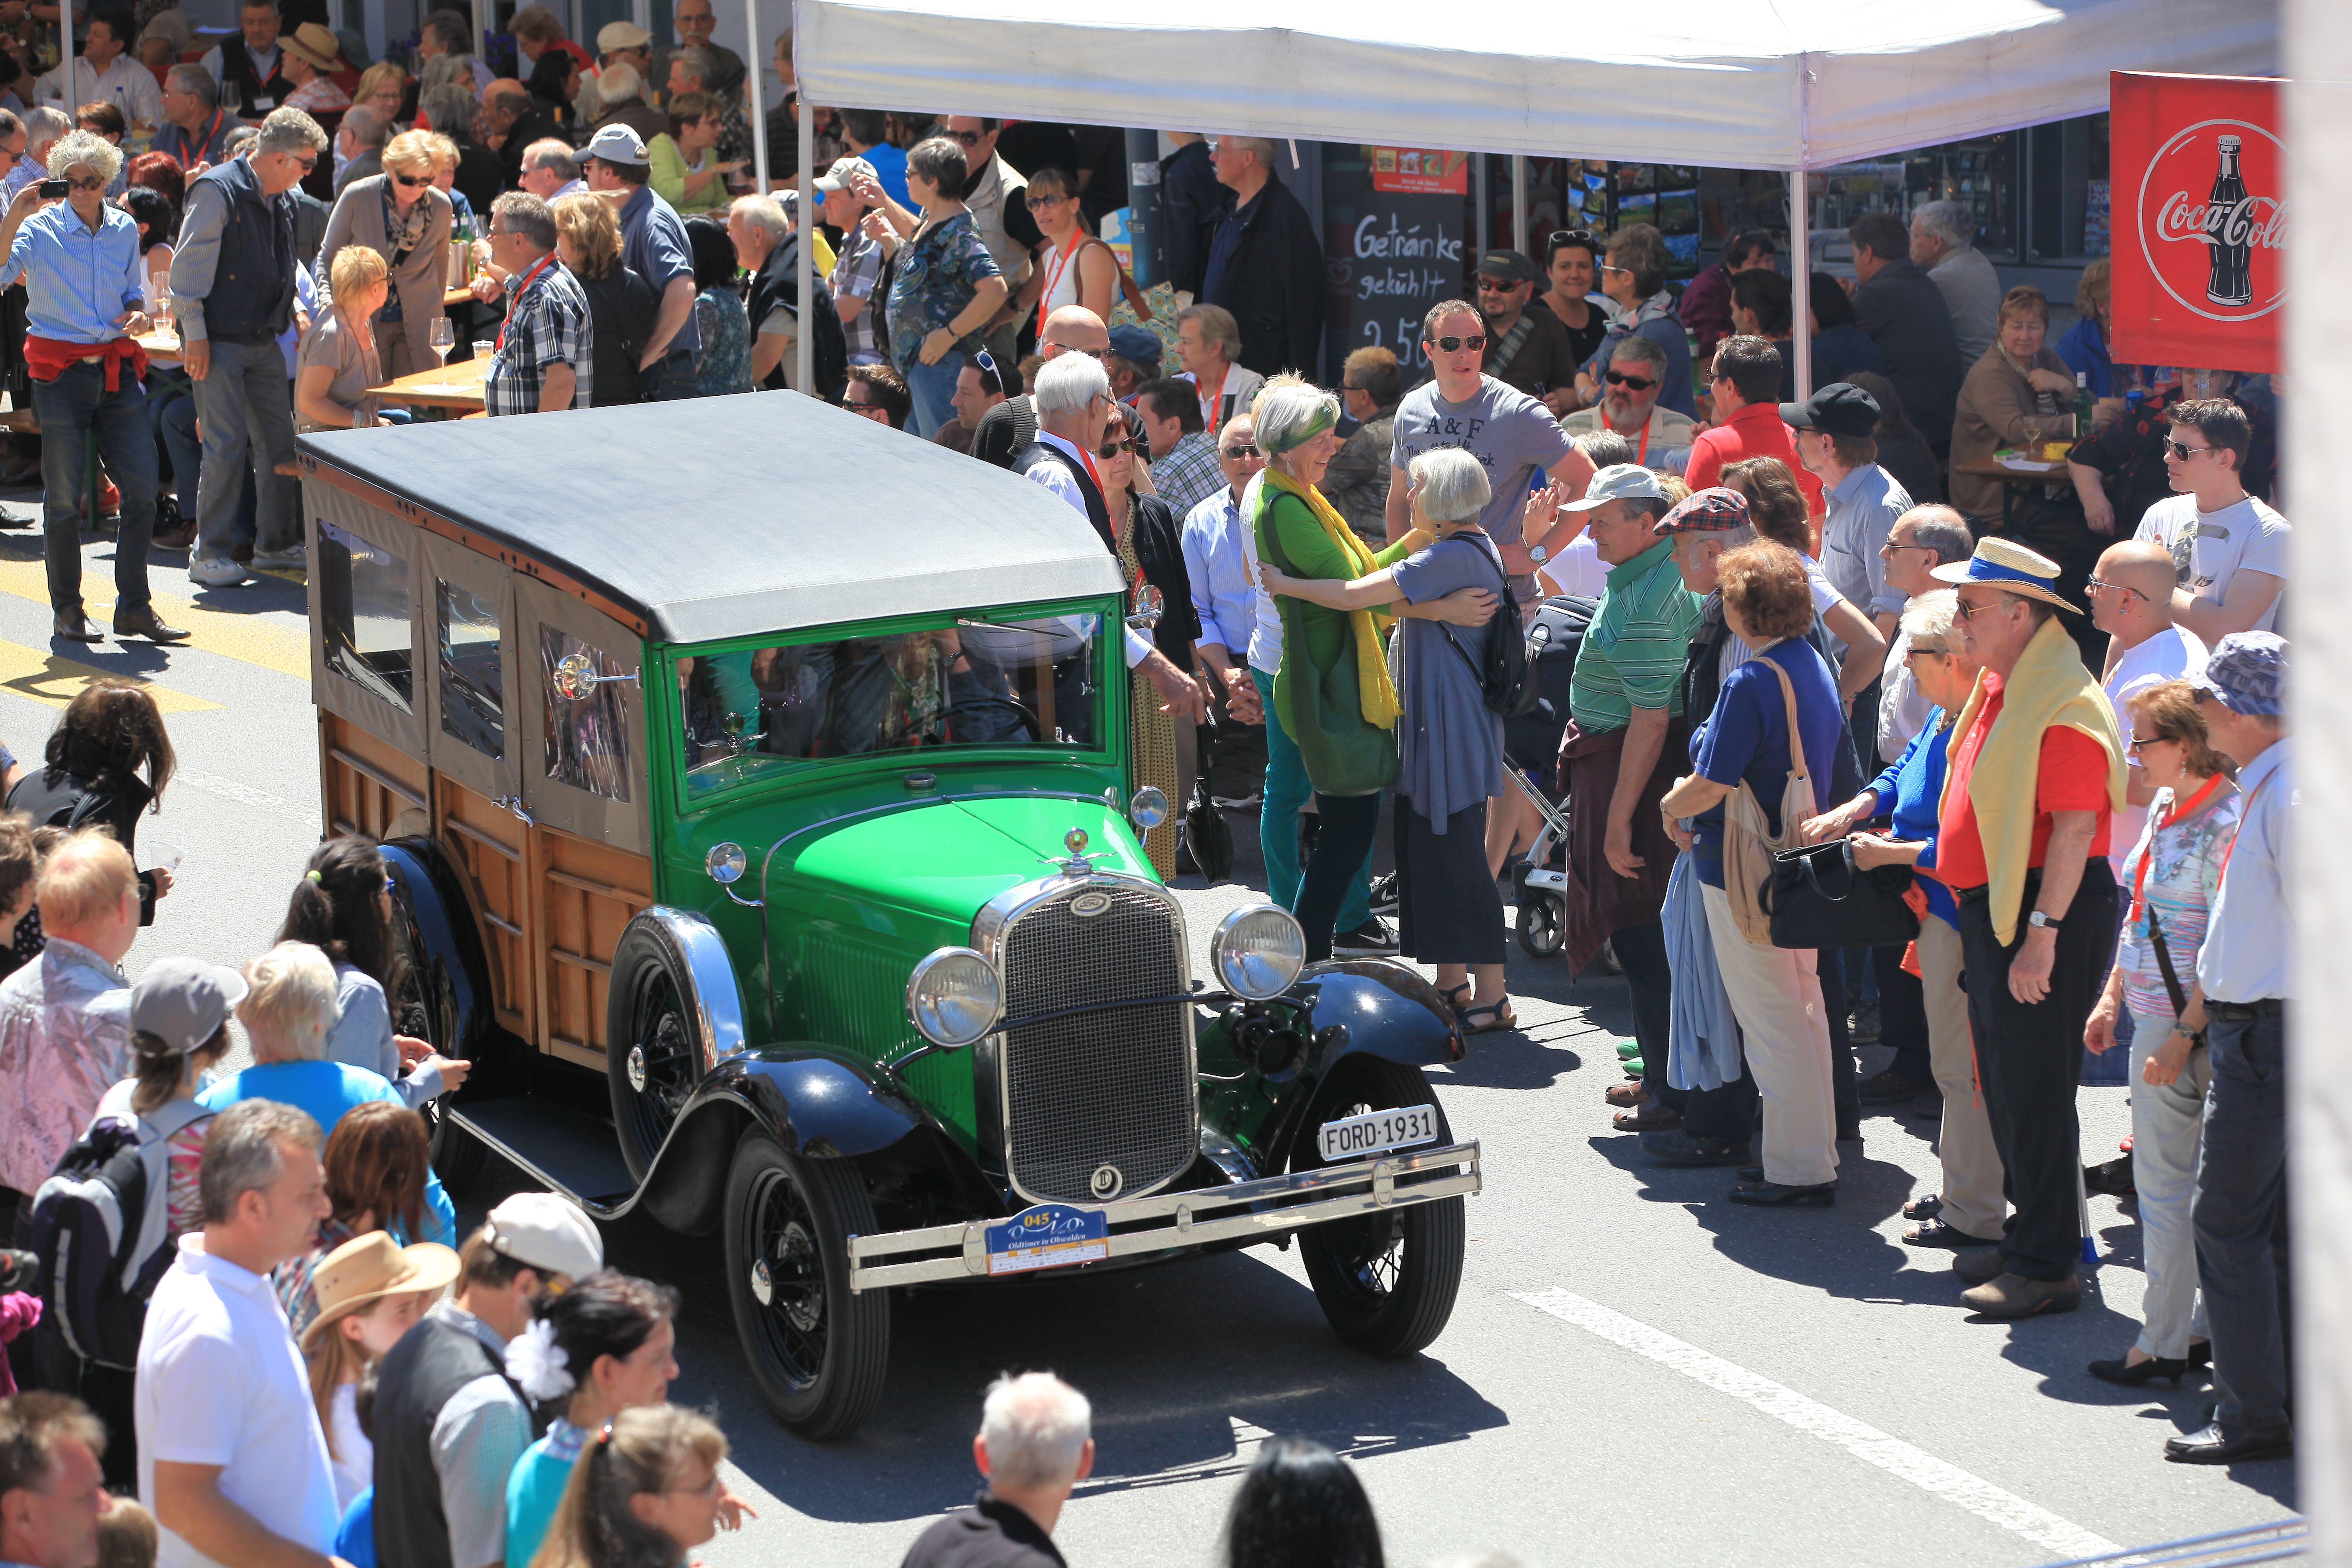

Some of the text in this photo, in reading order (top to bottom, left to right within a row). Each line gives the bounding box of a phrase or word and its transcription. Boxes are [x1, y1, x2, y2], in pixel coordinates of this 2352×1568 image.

[2156, 191, 2292, 249] Coca-Cola
[1354, 212, 1462, 261] Getränke
[1358, 267, 1445, 300] gekühlt
[1425, 415, 1485, 439] A & F
[1079, 897, 1102, 908] Ford
[1024, 1212, 1050, 1227] 045
[1008, 1240, 1040, 1250] Oldtimer
[1050, 1233, 1086, 1243] Obwalden
